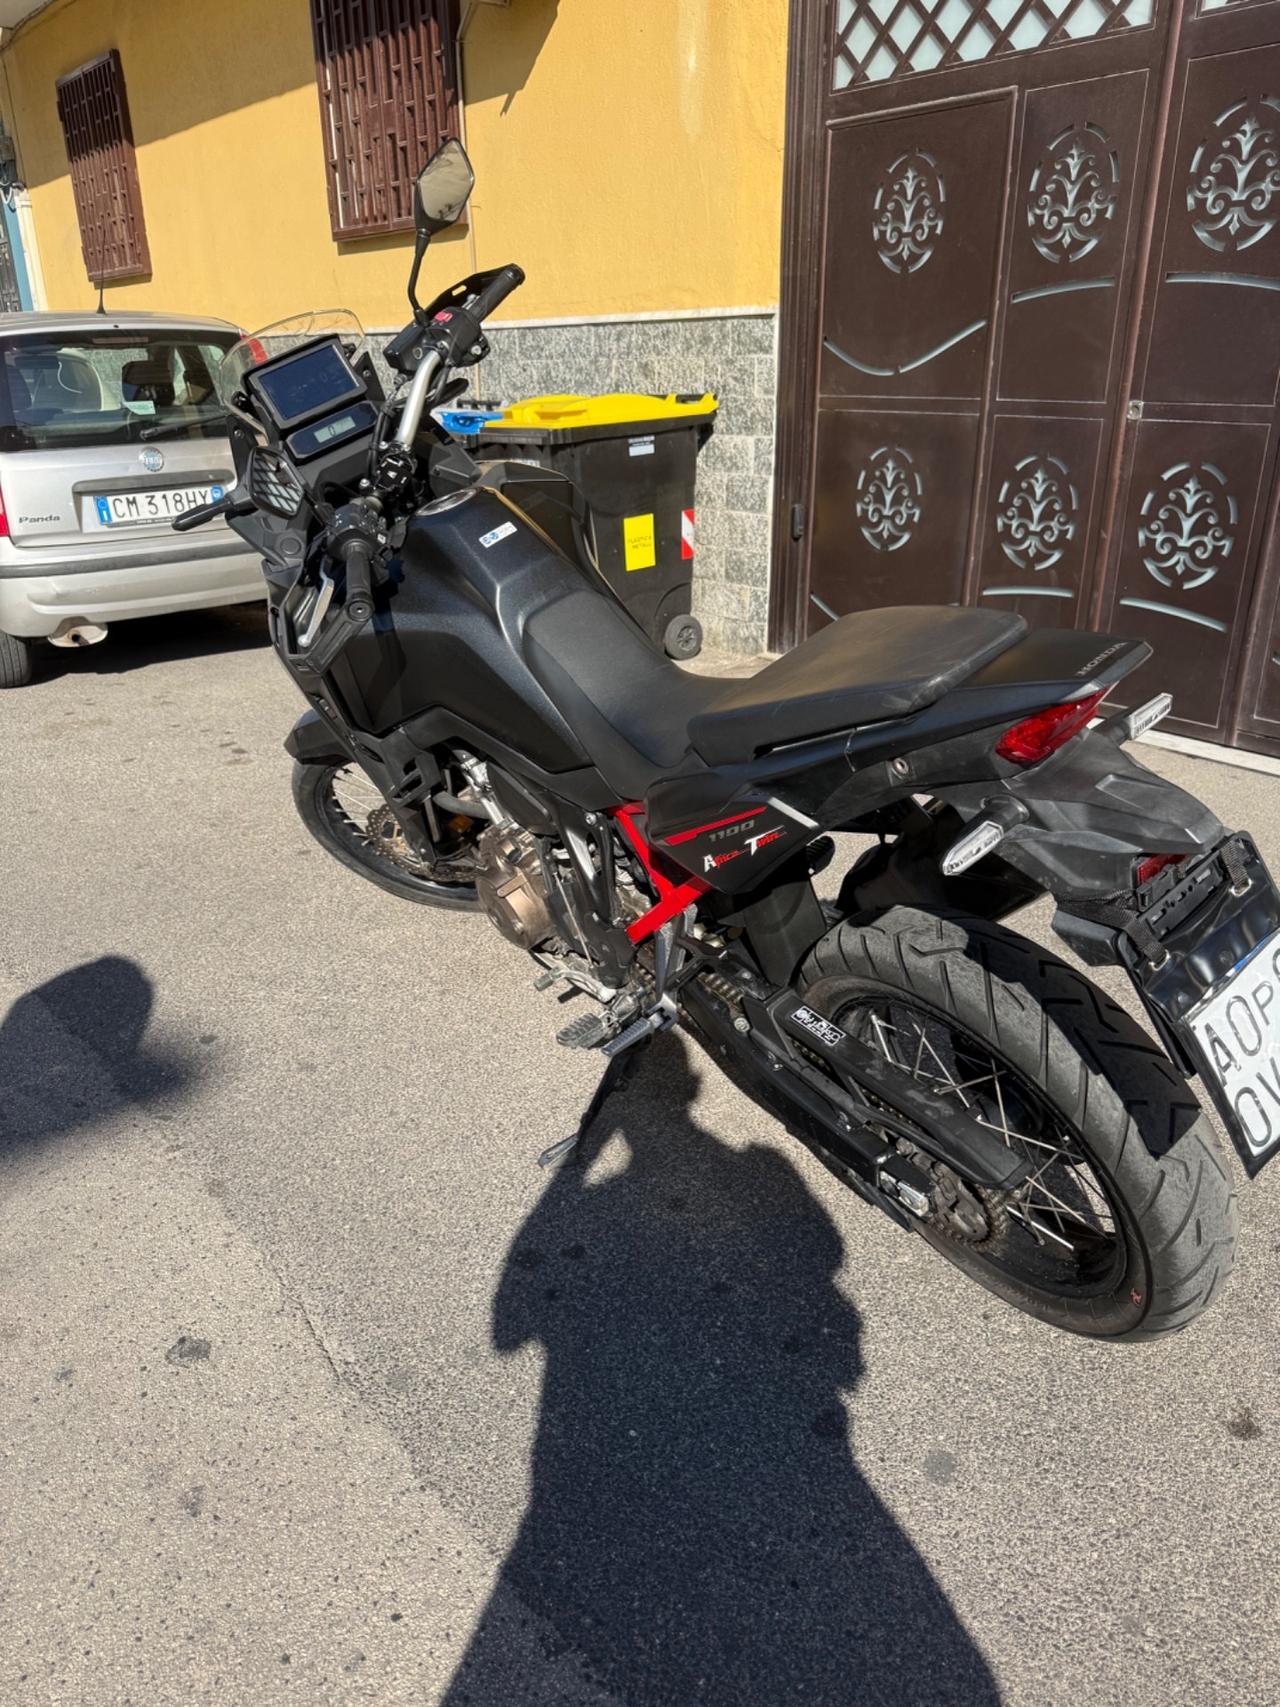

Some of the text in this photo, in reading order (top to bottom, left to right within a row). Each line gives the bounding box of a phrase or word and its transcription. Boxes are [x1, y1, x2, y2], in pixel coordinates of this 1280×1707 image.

[113, 496, 140, 518] CM
[145, 490, 208, 515] 318HY
[18, 514, 61, 524] Panda
[1075, 642, 1128, 676] HONDA
[708, 820, 755, 842] 1100
[703, 825, 787, 873] Africa Twin
